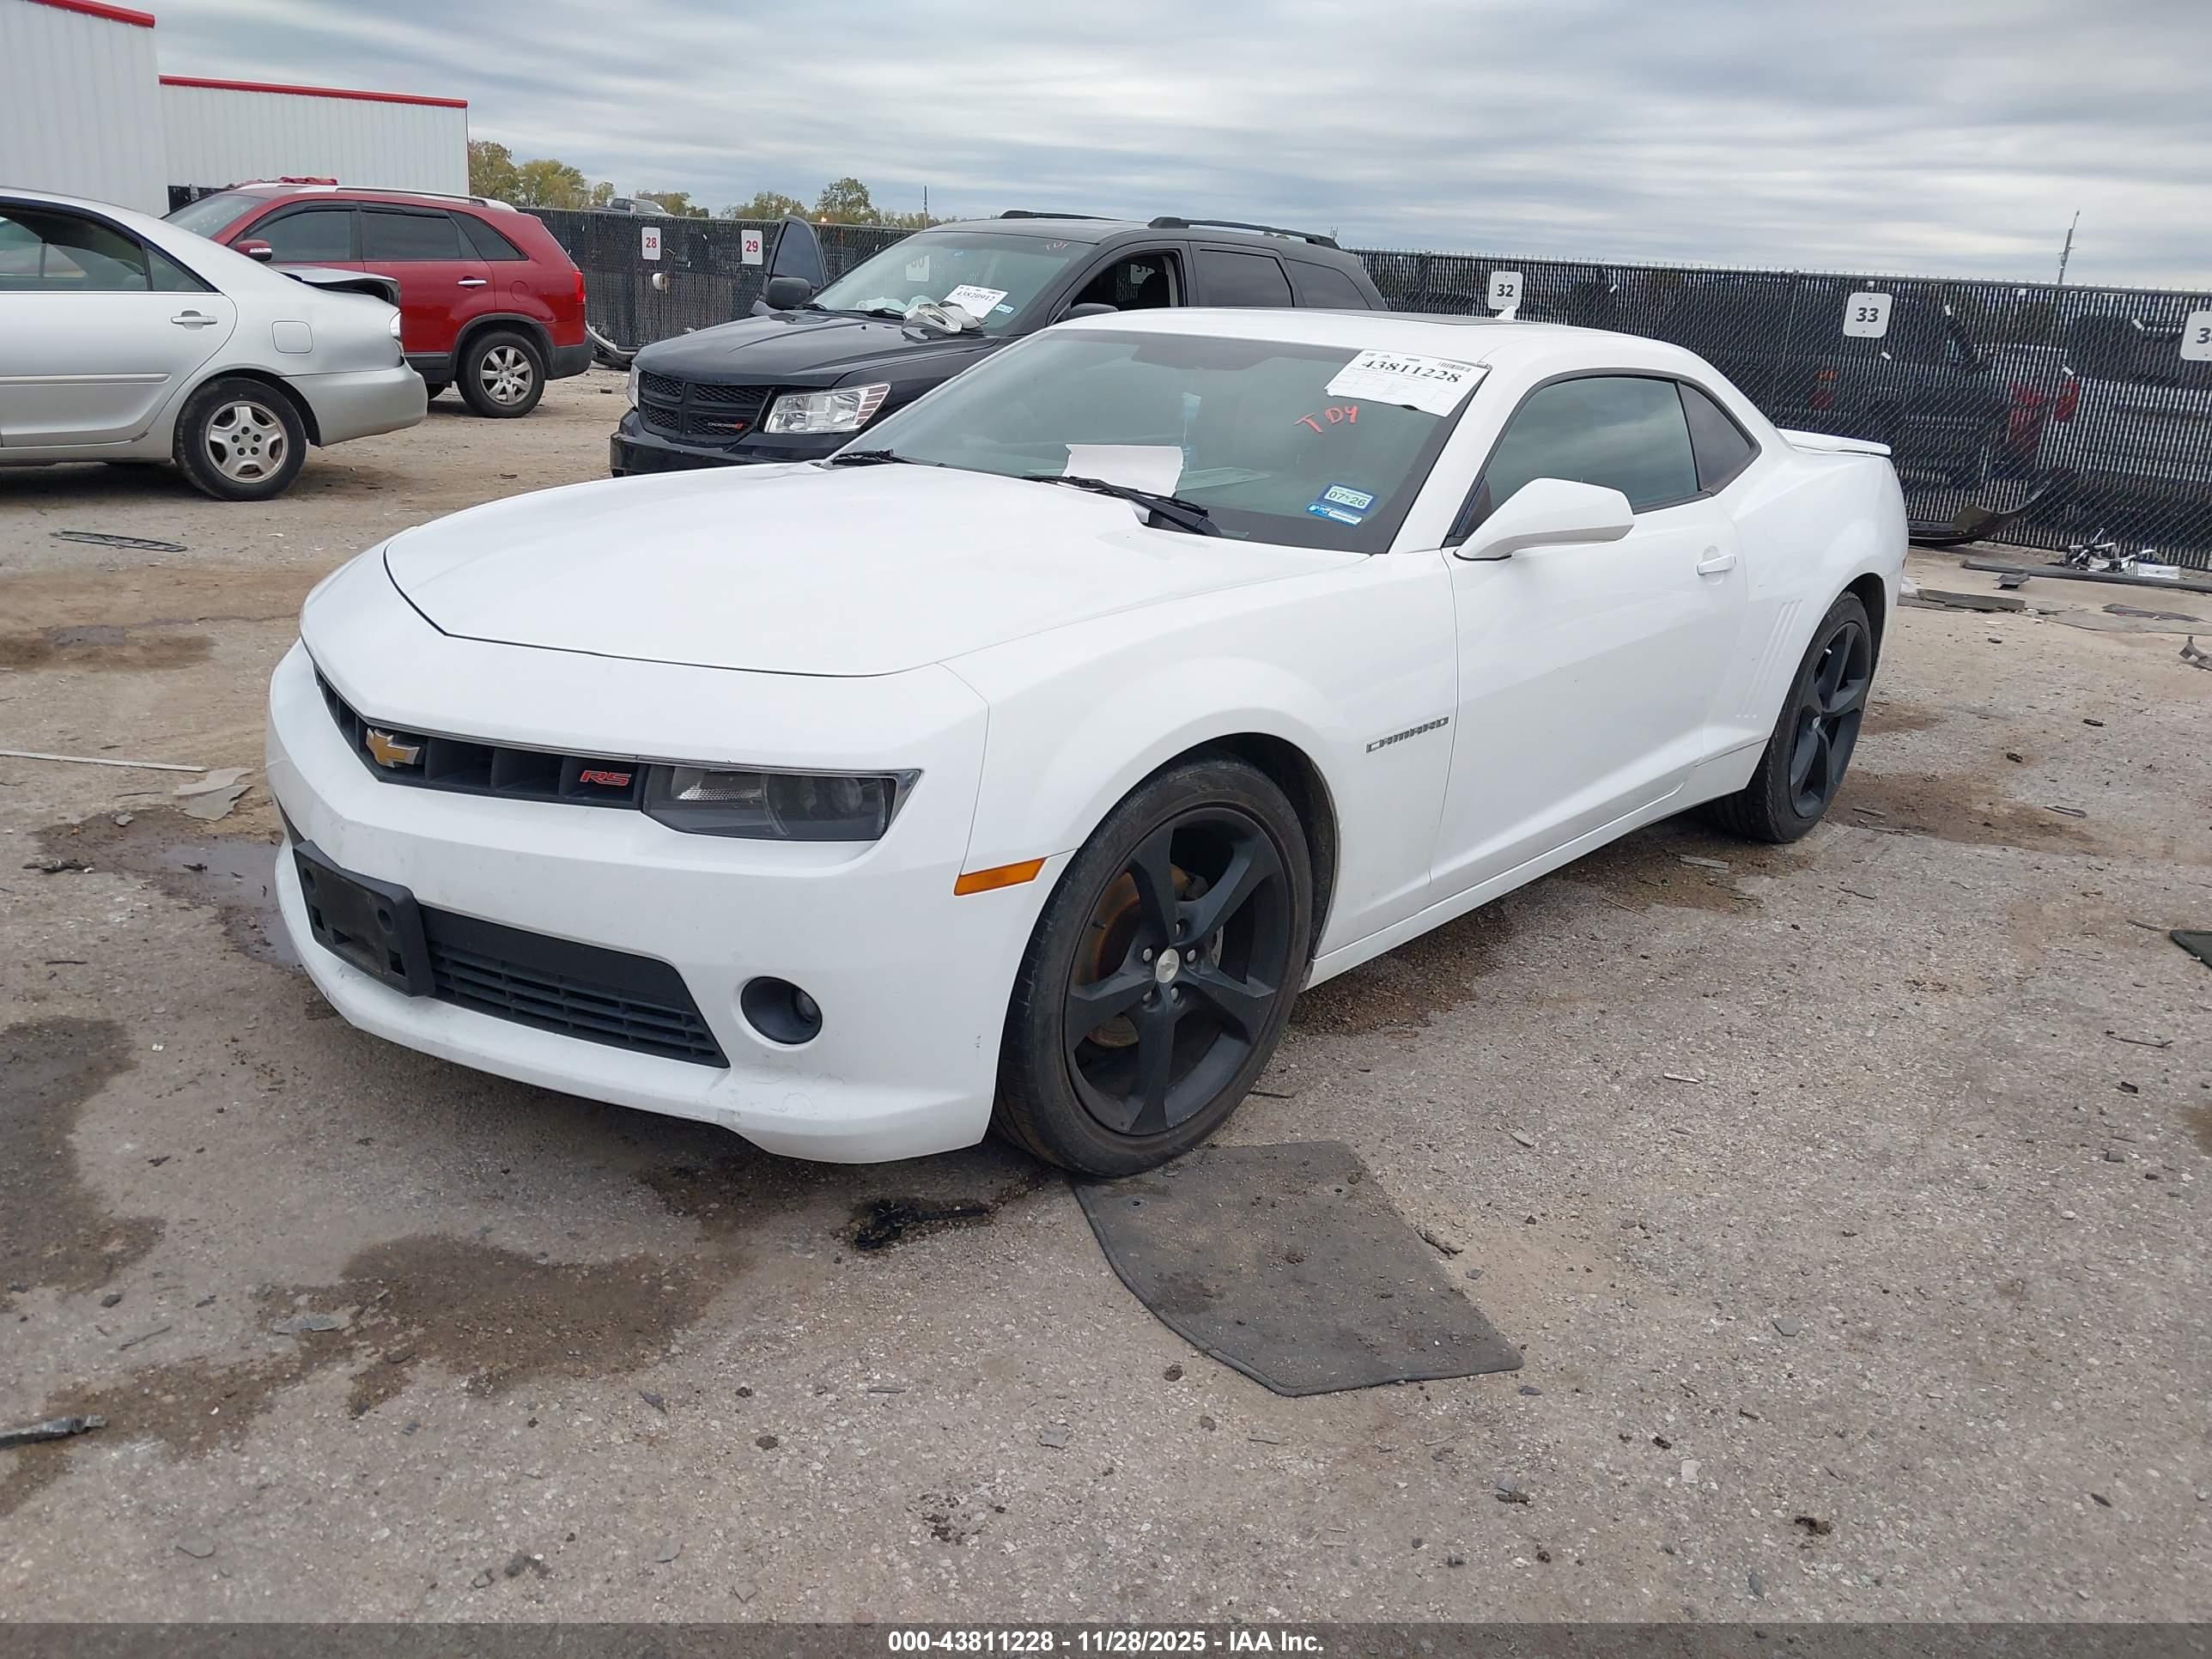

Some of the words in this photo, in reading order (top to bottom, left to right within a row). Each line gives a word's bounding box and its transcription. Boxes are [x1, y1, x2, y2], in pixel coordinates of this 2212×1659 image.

[645, 237, 658, 248] 28
[745, 240, 759, 252] 29
[1497, 283, 1514, 297] 32
[1856, 307, 1879, 322] 33
[2196, 327, 2212, 344] 3
[1361, 359, 1462, 384] 43811228
[1365, 716, 1449, 753] CAMARO
[580, 769, 632, 787] RS
